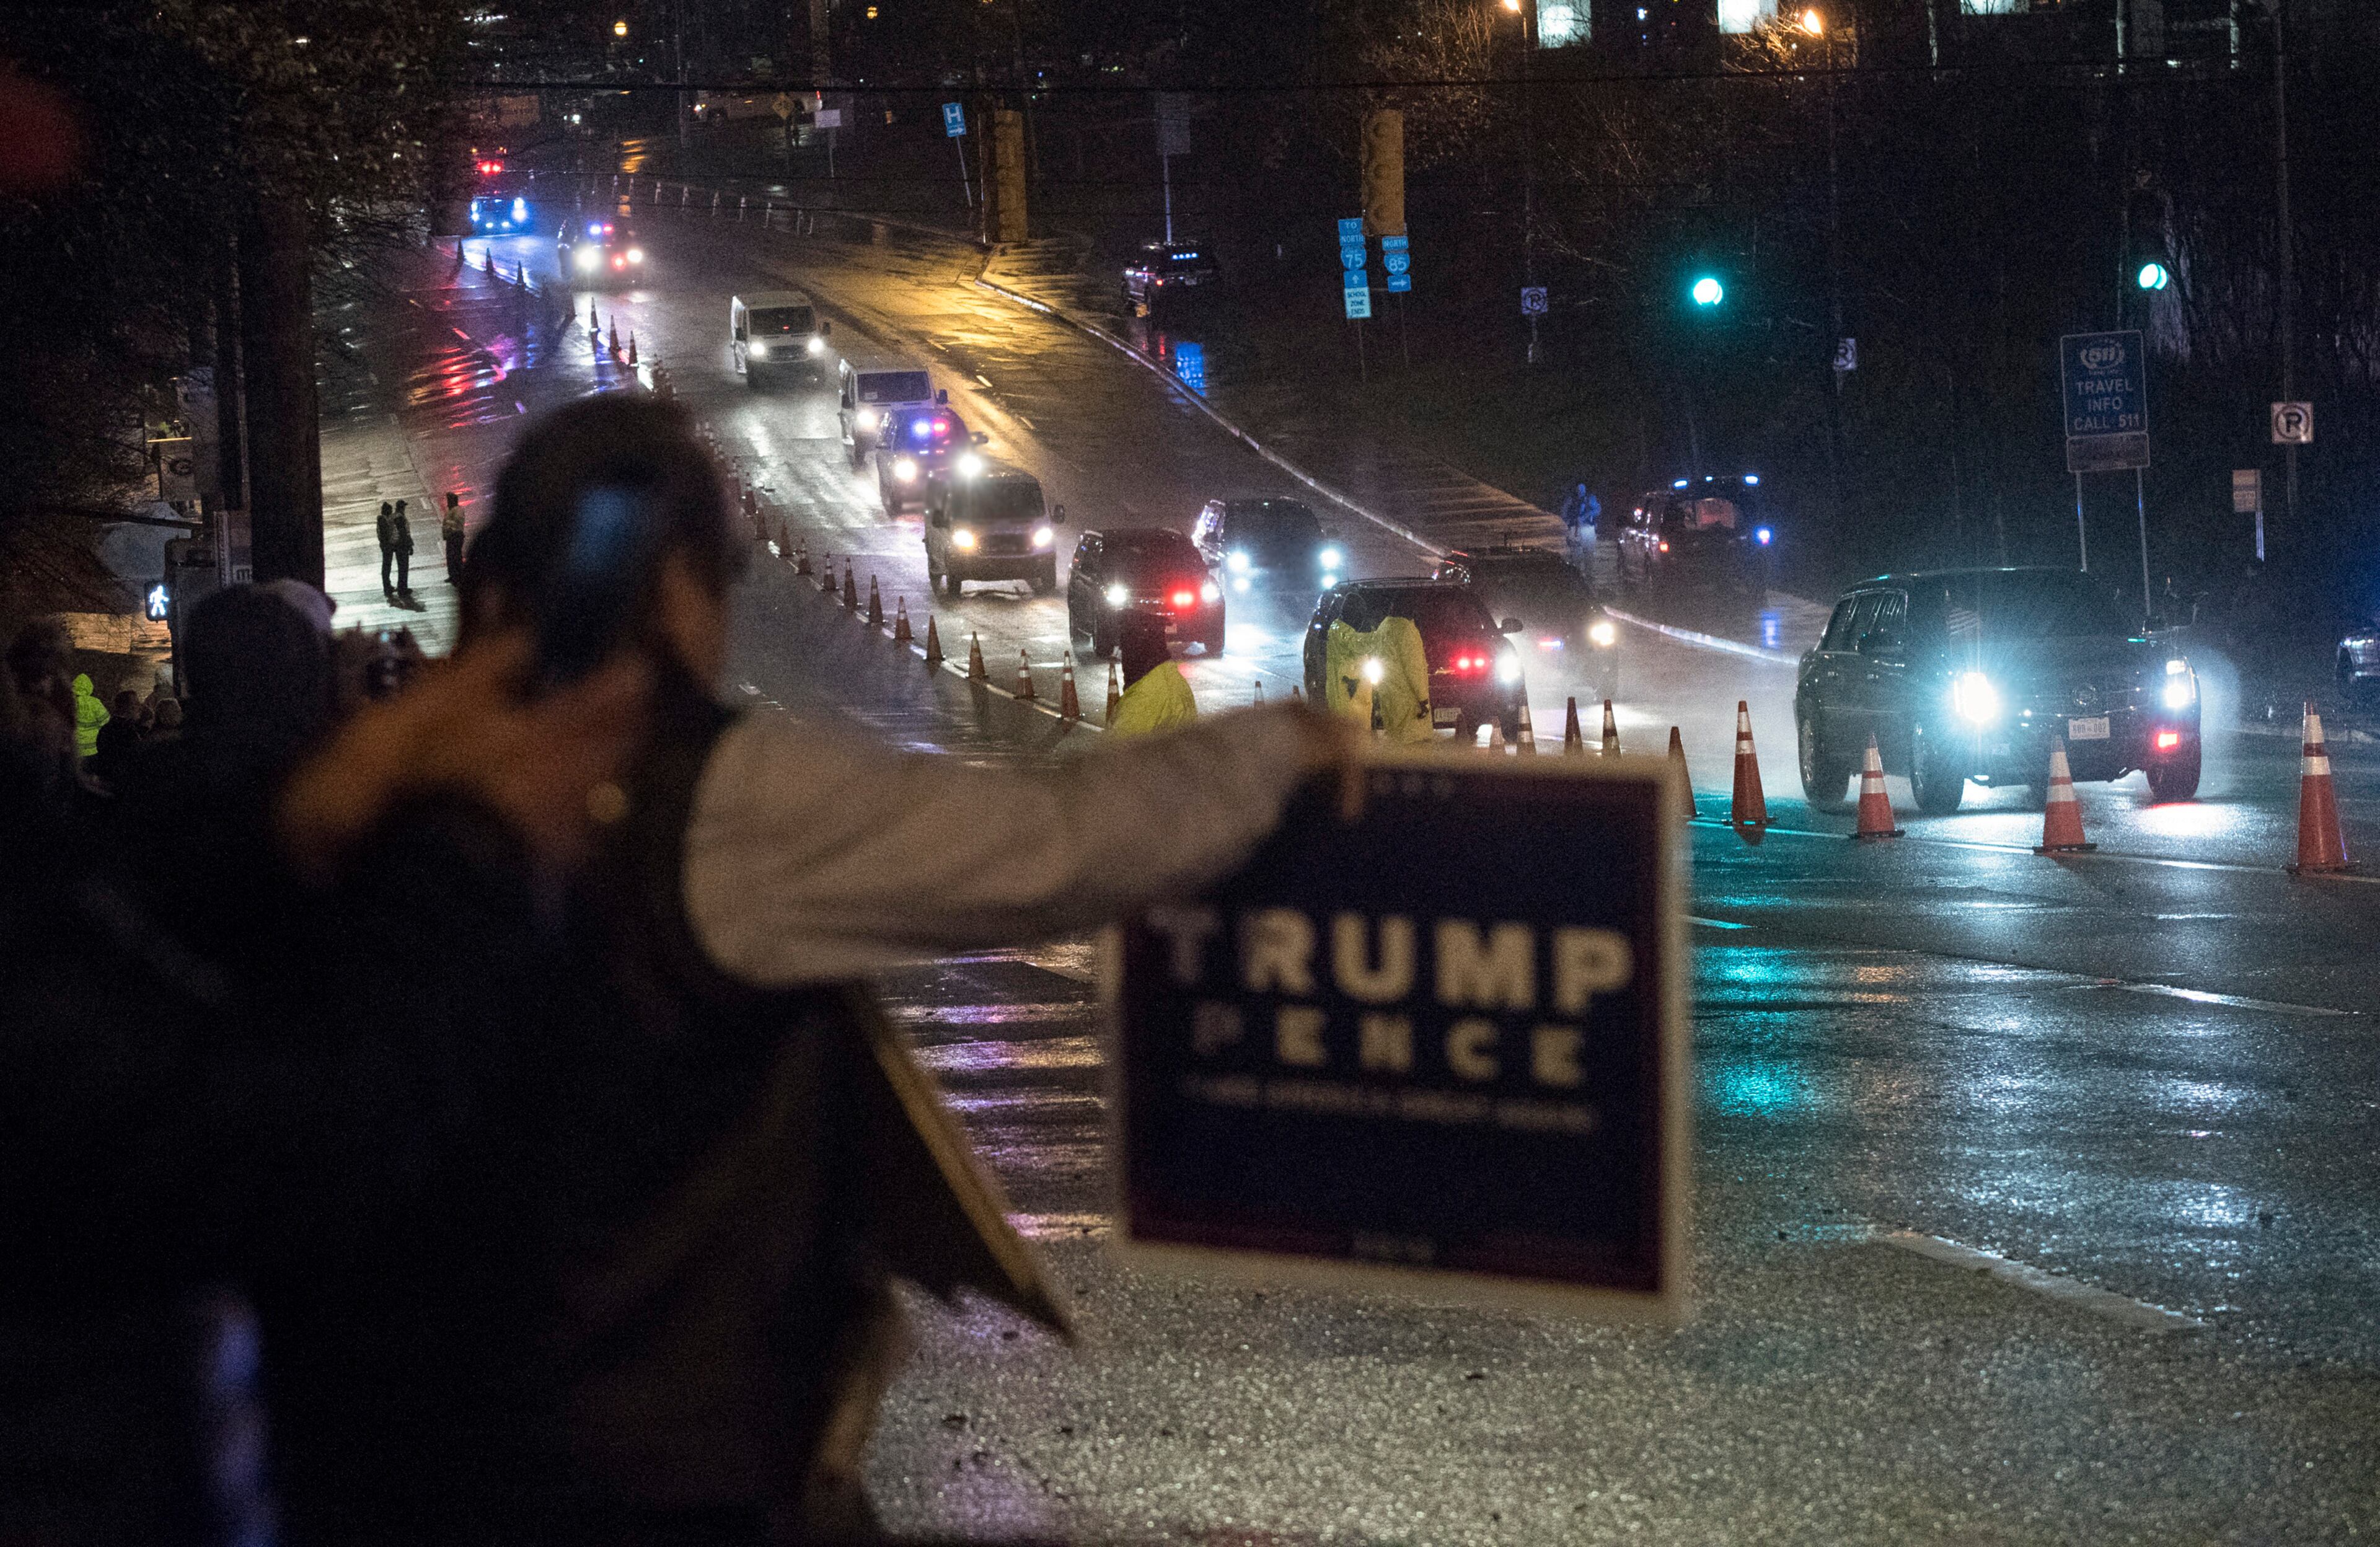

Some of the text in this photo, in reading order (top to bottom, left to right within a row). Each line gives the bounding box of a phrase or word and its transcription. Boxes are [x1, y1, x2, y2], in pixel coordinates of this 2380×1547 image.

[946, 106, 961, 123] H
[1341, 234, 1364, 244] NORTH
[1383, 240, 1406, 248] NORTH
[1346, 254, 1363, 268] 75
[1389, 257, 1406, 271] 85
[2076, 379, 2133, 395] TRAVEL
[2087, 397, 2122, 412] INFO
[2074, 413, 2138, 430] CALL 511
[1145, 907, 1635, 1013] TRUMP
[1193, 1000, 1587, 1088] PENCE
